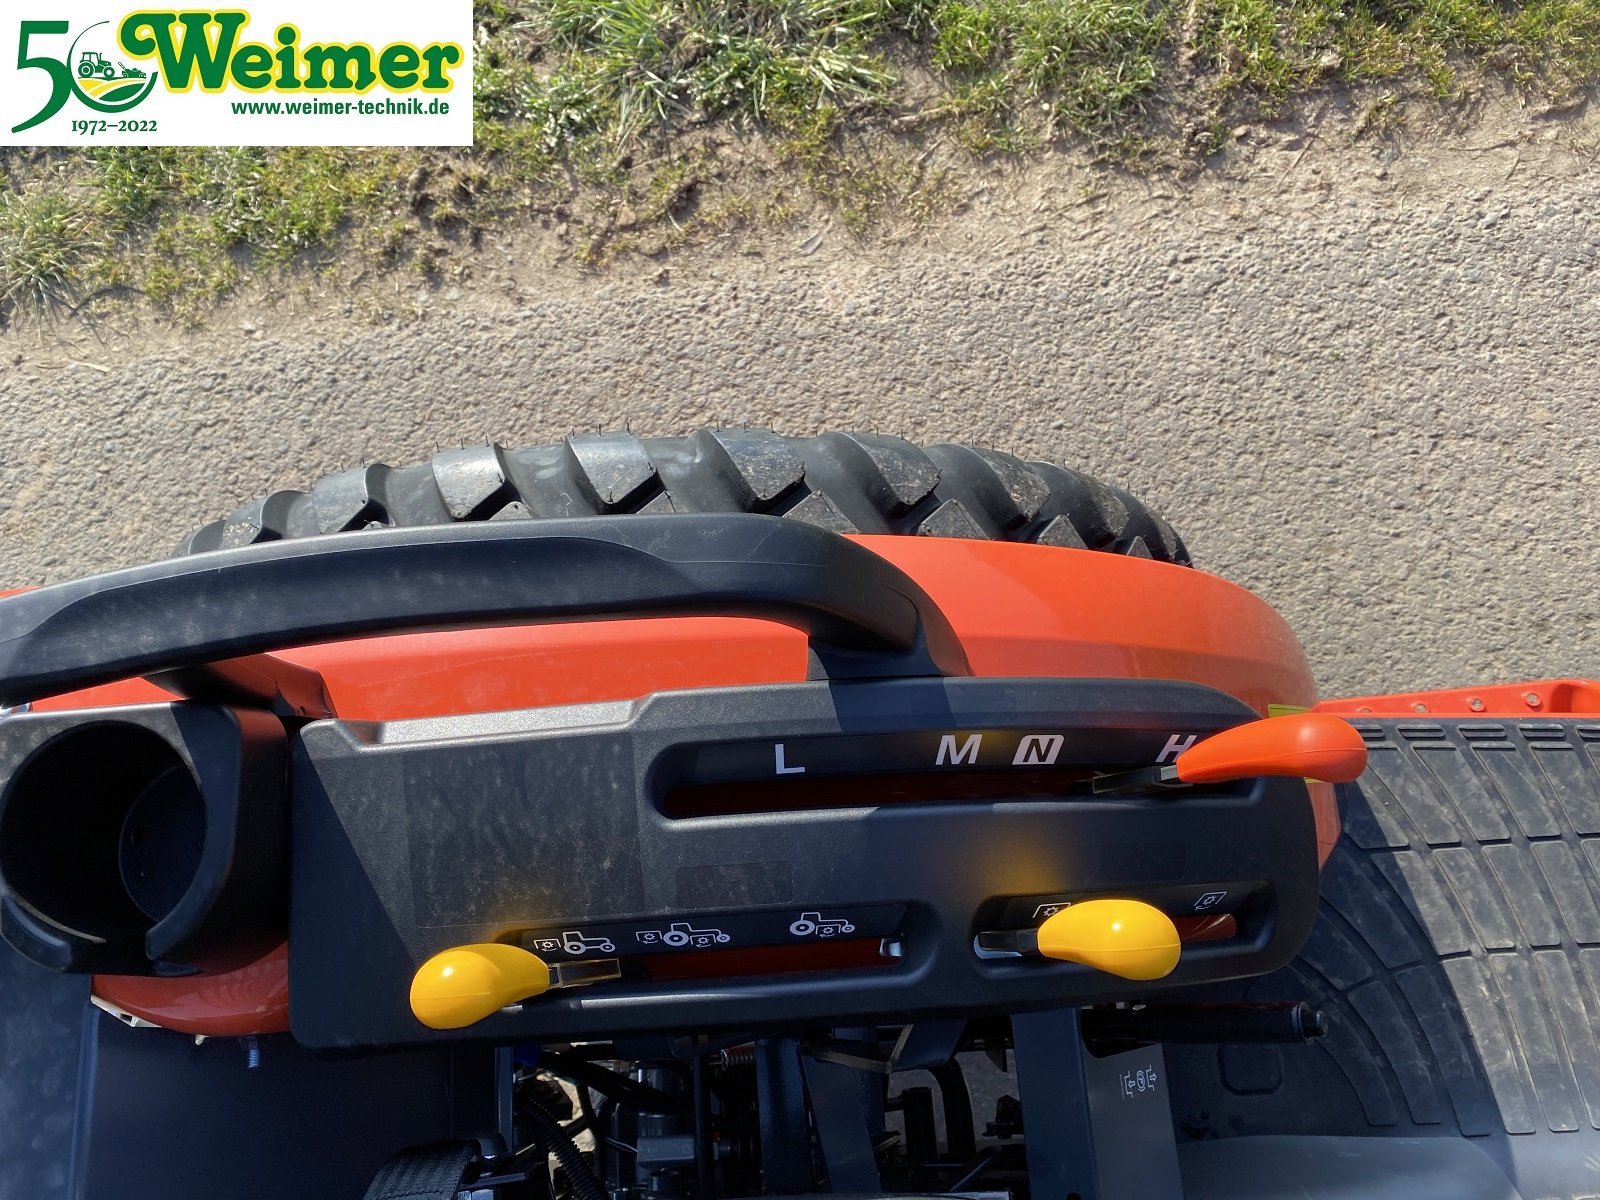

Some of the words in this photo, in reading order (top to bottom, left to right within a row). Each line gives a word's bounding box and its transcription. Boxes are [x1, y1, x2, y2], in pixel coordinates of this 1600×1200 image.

[774, 743, 805, 774] L
[936, 734, 982, 765] M
[1018, 736, 1055, 764] N
[1155, 734, 1198, 763] H
